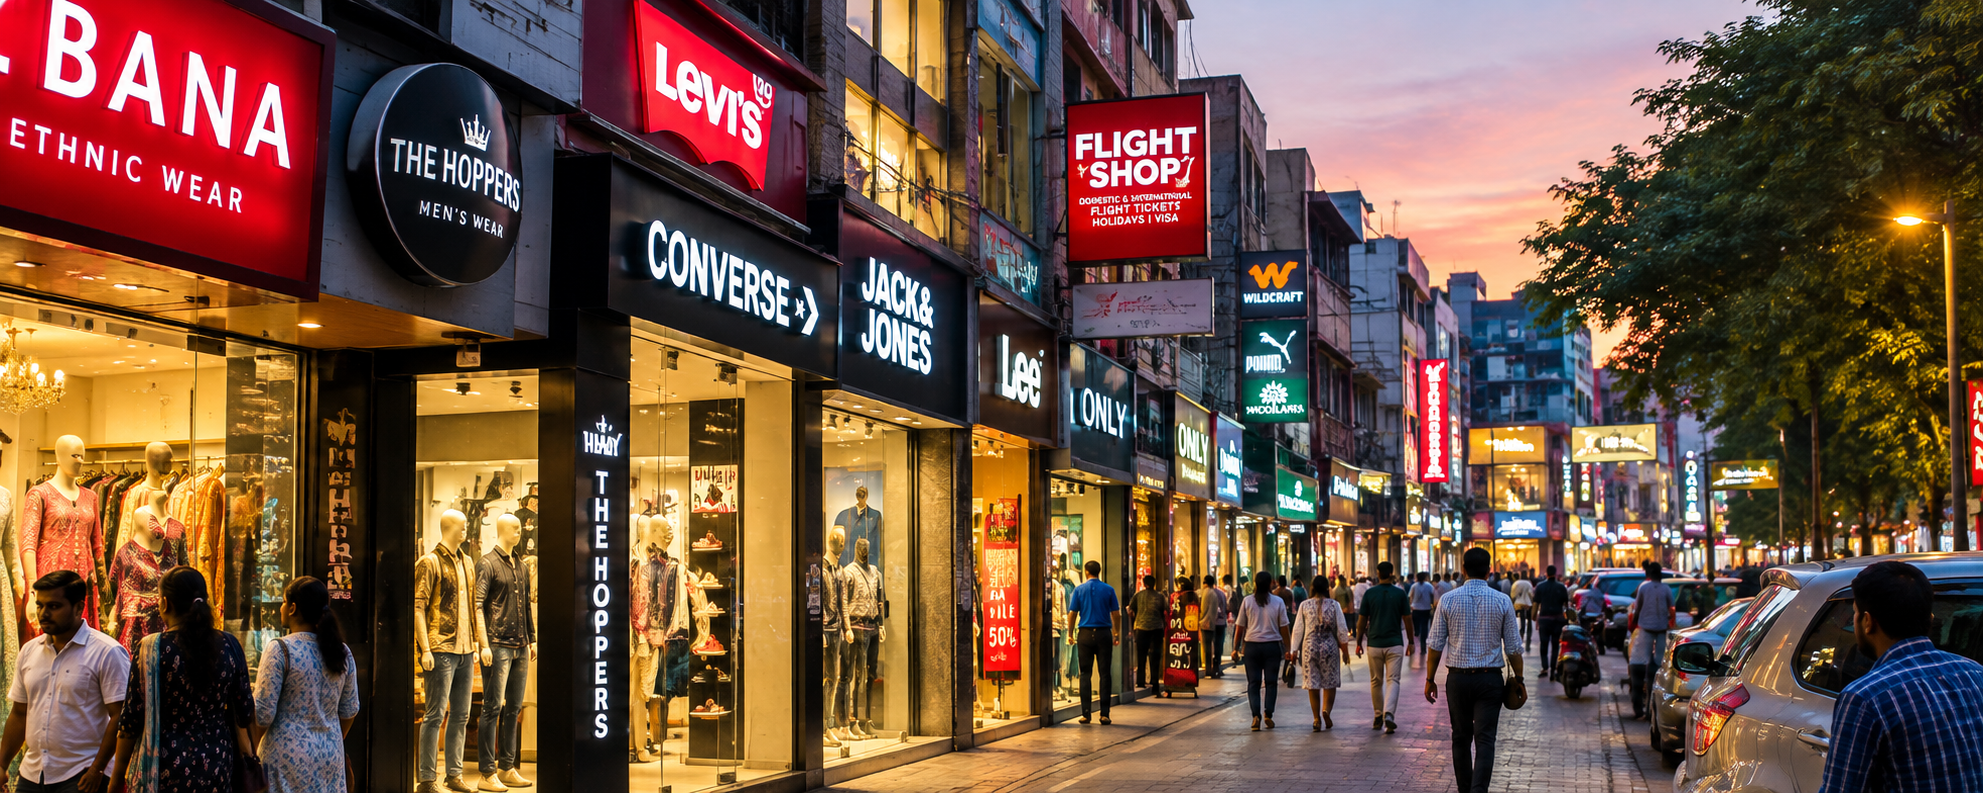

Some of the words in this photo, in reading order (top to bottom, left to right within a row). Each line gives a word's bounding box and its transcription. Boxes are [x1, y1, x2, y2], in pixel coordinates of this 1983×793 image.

[0, 0, 291, 169] BANA
[10, 117, 142, 183] ETHNIC
[162, 165, 242, 213] WEAR
[1075, 126, 1197, 160] FLIGHT
[390, 138, 437, 180] THE
[442, 148, 520, 213] HOPPERS
[1089, 157, 1181, 188] SHOP
[419, 200, 467, 225] MEN'S
[473, 213, 504, 238] WEAR
[1090, 204, 1131, 216] FLIGHT
[1133, 201, 1181, 213] TICKETS
[1092, 214, 1145, 227] HOLIDAYS
[1154, 213, 1179, 223] VISA
[648, 219, 790, 328] CONVERSE
[1243, 291, 1304, 304] WILDCRAFT
[861, 308, 932, 375] JONES
[1002, 333, 1042, 409] Lee
[1082, 387, 1127, 439] ONLY
[1178, 422, 1209, 467] ONLY
[593, 556, 611, 739] HOPPERS
